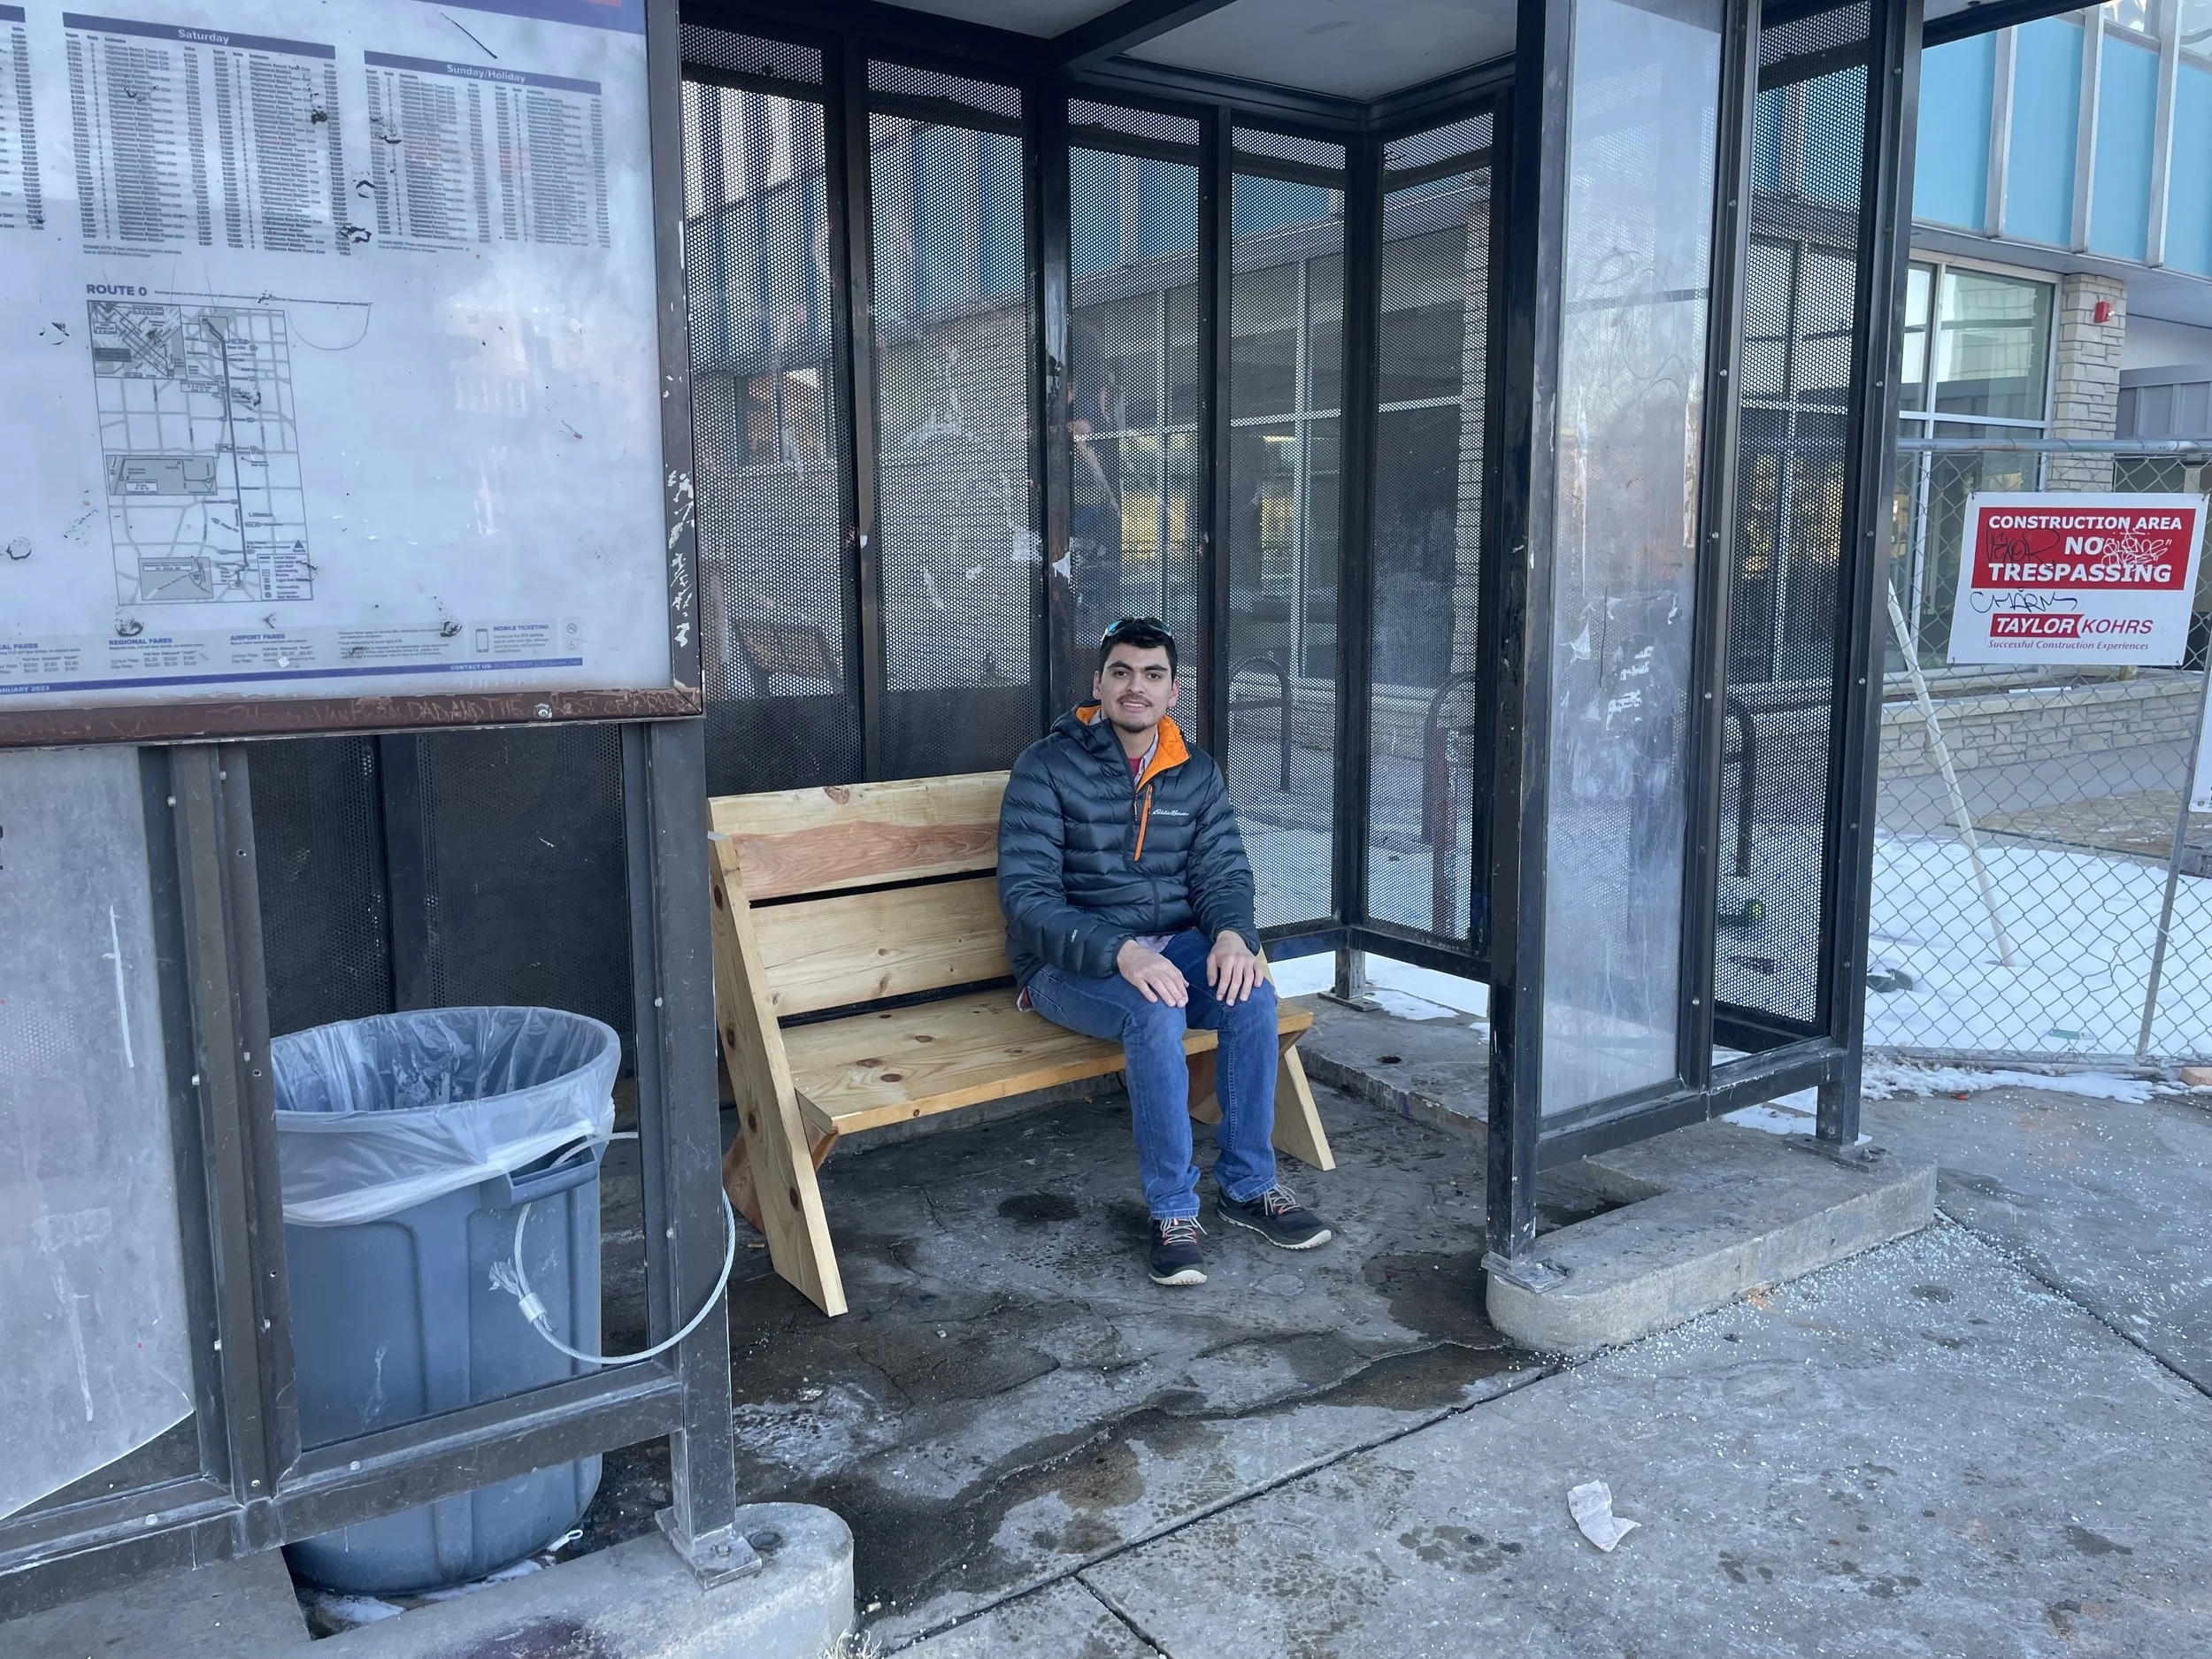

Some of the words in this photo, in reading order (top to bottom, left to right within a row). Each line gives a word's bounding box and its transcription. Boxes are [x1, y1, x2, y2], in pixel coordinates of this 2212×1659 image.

[178, 28, 229, 45] Saturday
[446, 64, 526, 84] Sunday/Holiday
[86, 283, 135, 296] ROUTE
[1988, 515, 2131, 530] CONSTRUCTION
[2135, 517, 2182, 530] AREA
[2064, 536, 2103, 556] NO
[1988, 563, 2172, 582] TRESPASSING
[1996, 618, 2076, 634] TAYLOR
[2080, 618, 2154, 634] KOHRS
[1988, 640, 2034, 649] Successful
[2036, 641, 2094, 650] Construction
[2096, 641, 2149, 652] Experiences
